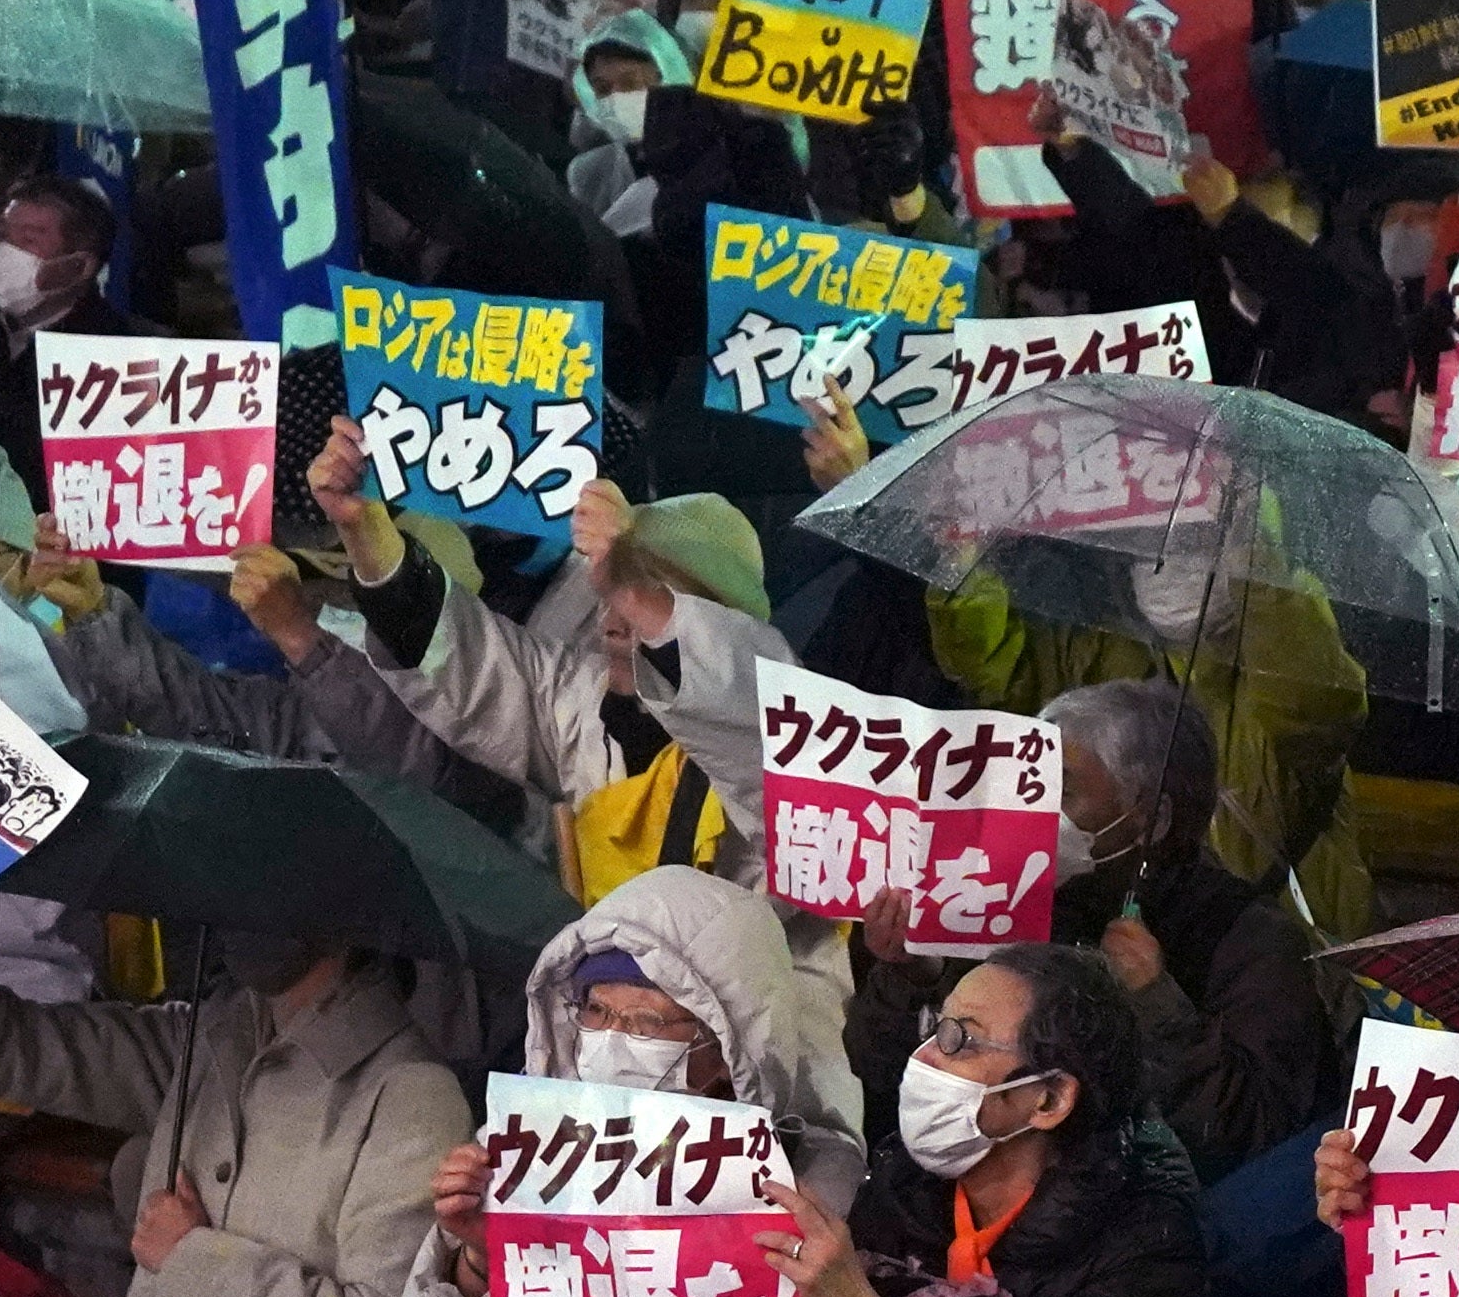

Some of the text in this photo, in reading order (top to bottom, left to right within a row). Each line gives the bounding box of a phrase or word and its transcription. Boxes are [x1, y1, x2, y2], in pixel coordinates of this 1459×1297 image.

[710, 221, 967, 329] ロシアは侵略を
[41, 349, 271, 431] ウクライナから
[343, 285, 598, 400] ロシアは侵略を
[712, 312, 961, 428] やめろ
[951, 313, 1192, 413] ウクライナから
[51, 442, 269, 551] 撤退を!
[359, 384, 599, 518] やめろ
[764, 694, 1055, 805] ウクライナから
[773, 800, 1050, 937] 撤退を!
[488, 1113, 783, 1206] ウクライナから
